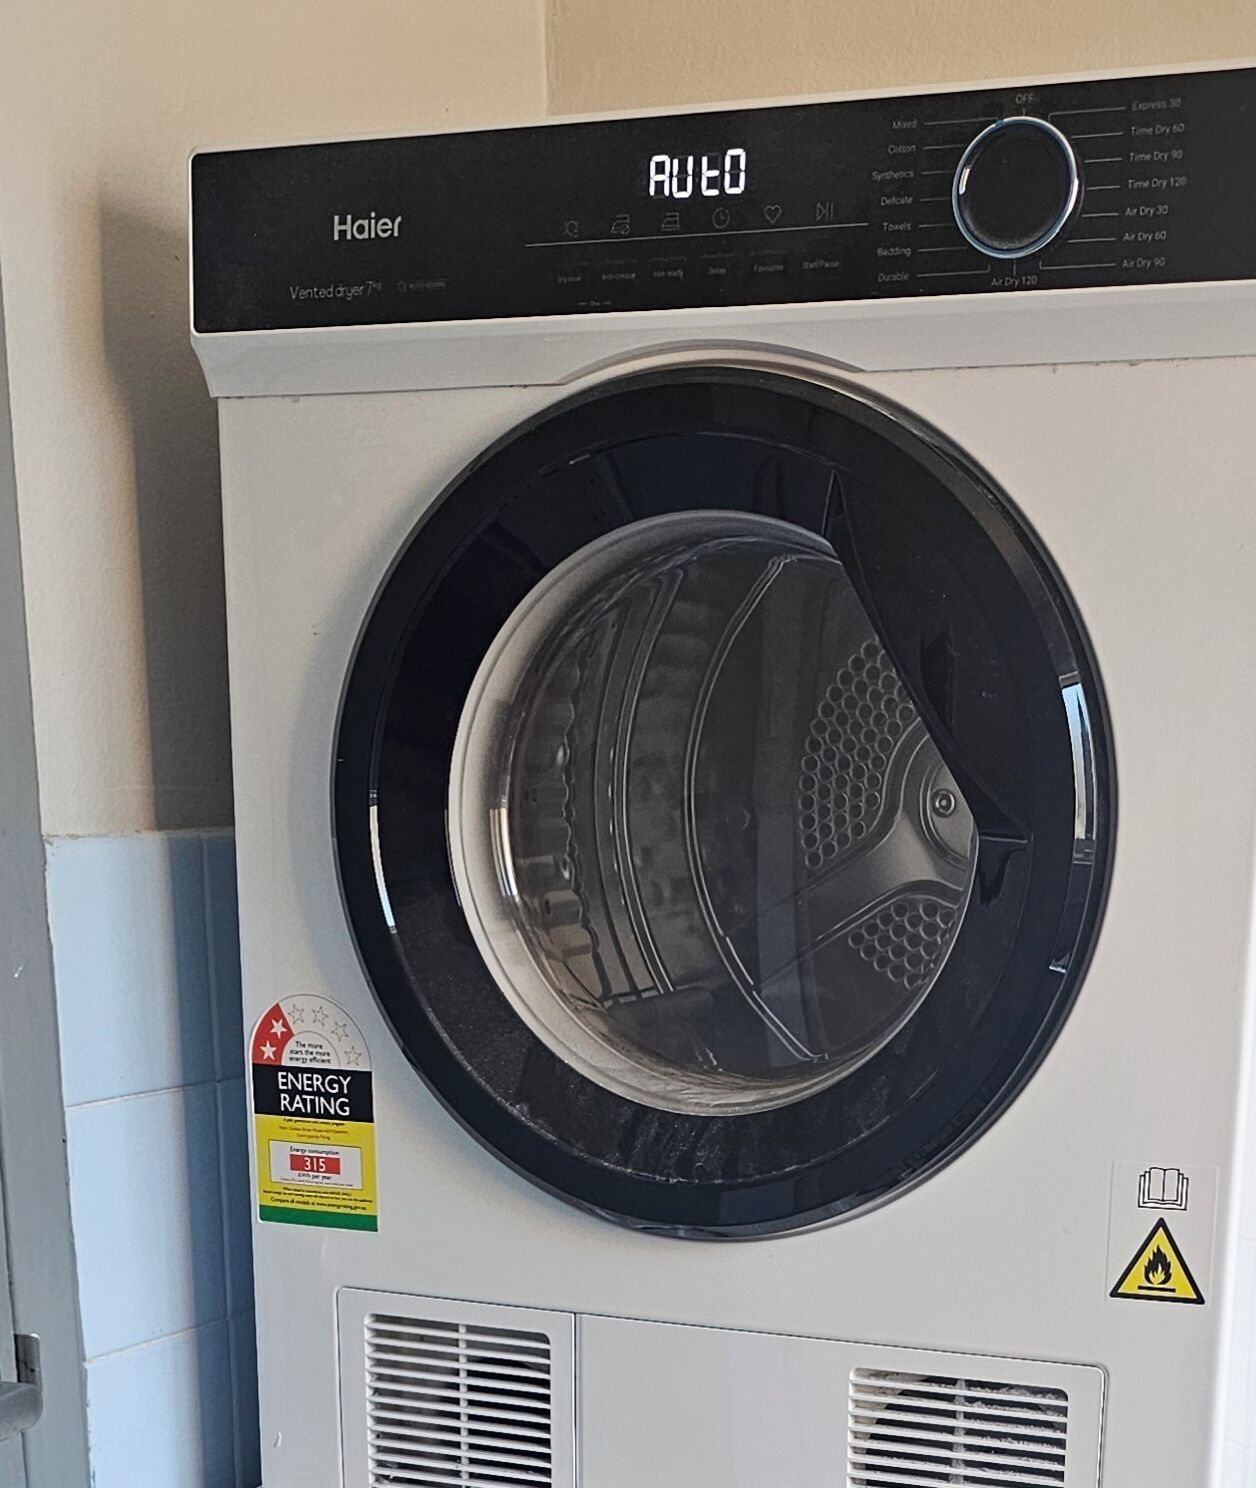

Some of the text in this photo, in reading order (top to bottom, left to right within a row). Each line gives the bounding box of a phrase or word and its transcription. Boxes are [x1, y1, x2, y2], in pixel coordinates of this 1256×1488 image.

[1015, 93, 1034, 104] OFF
[892, 119, 918, 129] Mixed
[1131, 123, 1185, 136] Time Dry 60
[1130, 149, 1183, 162] Time Dry 90
[872, 168, 914, 181] Synthetics
[1128, 176, 1186, 189] Time Dry 120
[881, 196, 913, 206] Delicate
[1125, 205, 1168, 217] Air Dry 30
[334, 211, 402, 241] Haier
[883, 222, 911, 231] Towels
[1123, 230, 1167, 242] Air Dry 60
[877, 247, 911, 257] Bedding
[1122, 257, 1166, 269] Air Dry 90
[879, 272, 909, 282] Durable
[991, 275, 1037, 288] Air Dry 120
[289, 284, 334, 300] Vented
[335, 283, 364, 300] dryer
[296, 1040, 306, 1048] The
[289, 1056, 307, 1064] energy
[278, 1071, 351, 1094] ENERGY
[280, 1093, 350, 1116] RATING
[290, 1145, 307, 1154] Energy
[303, 1157, 326, 1172] 315
